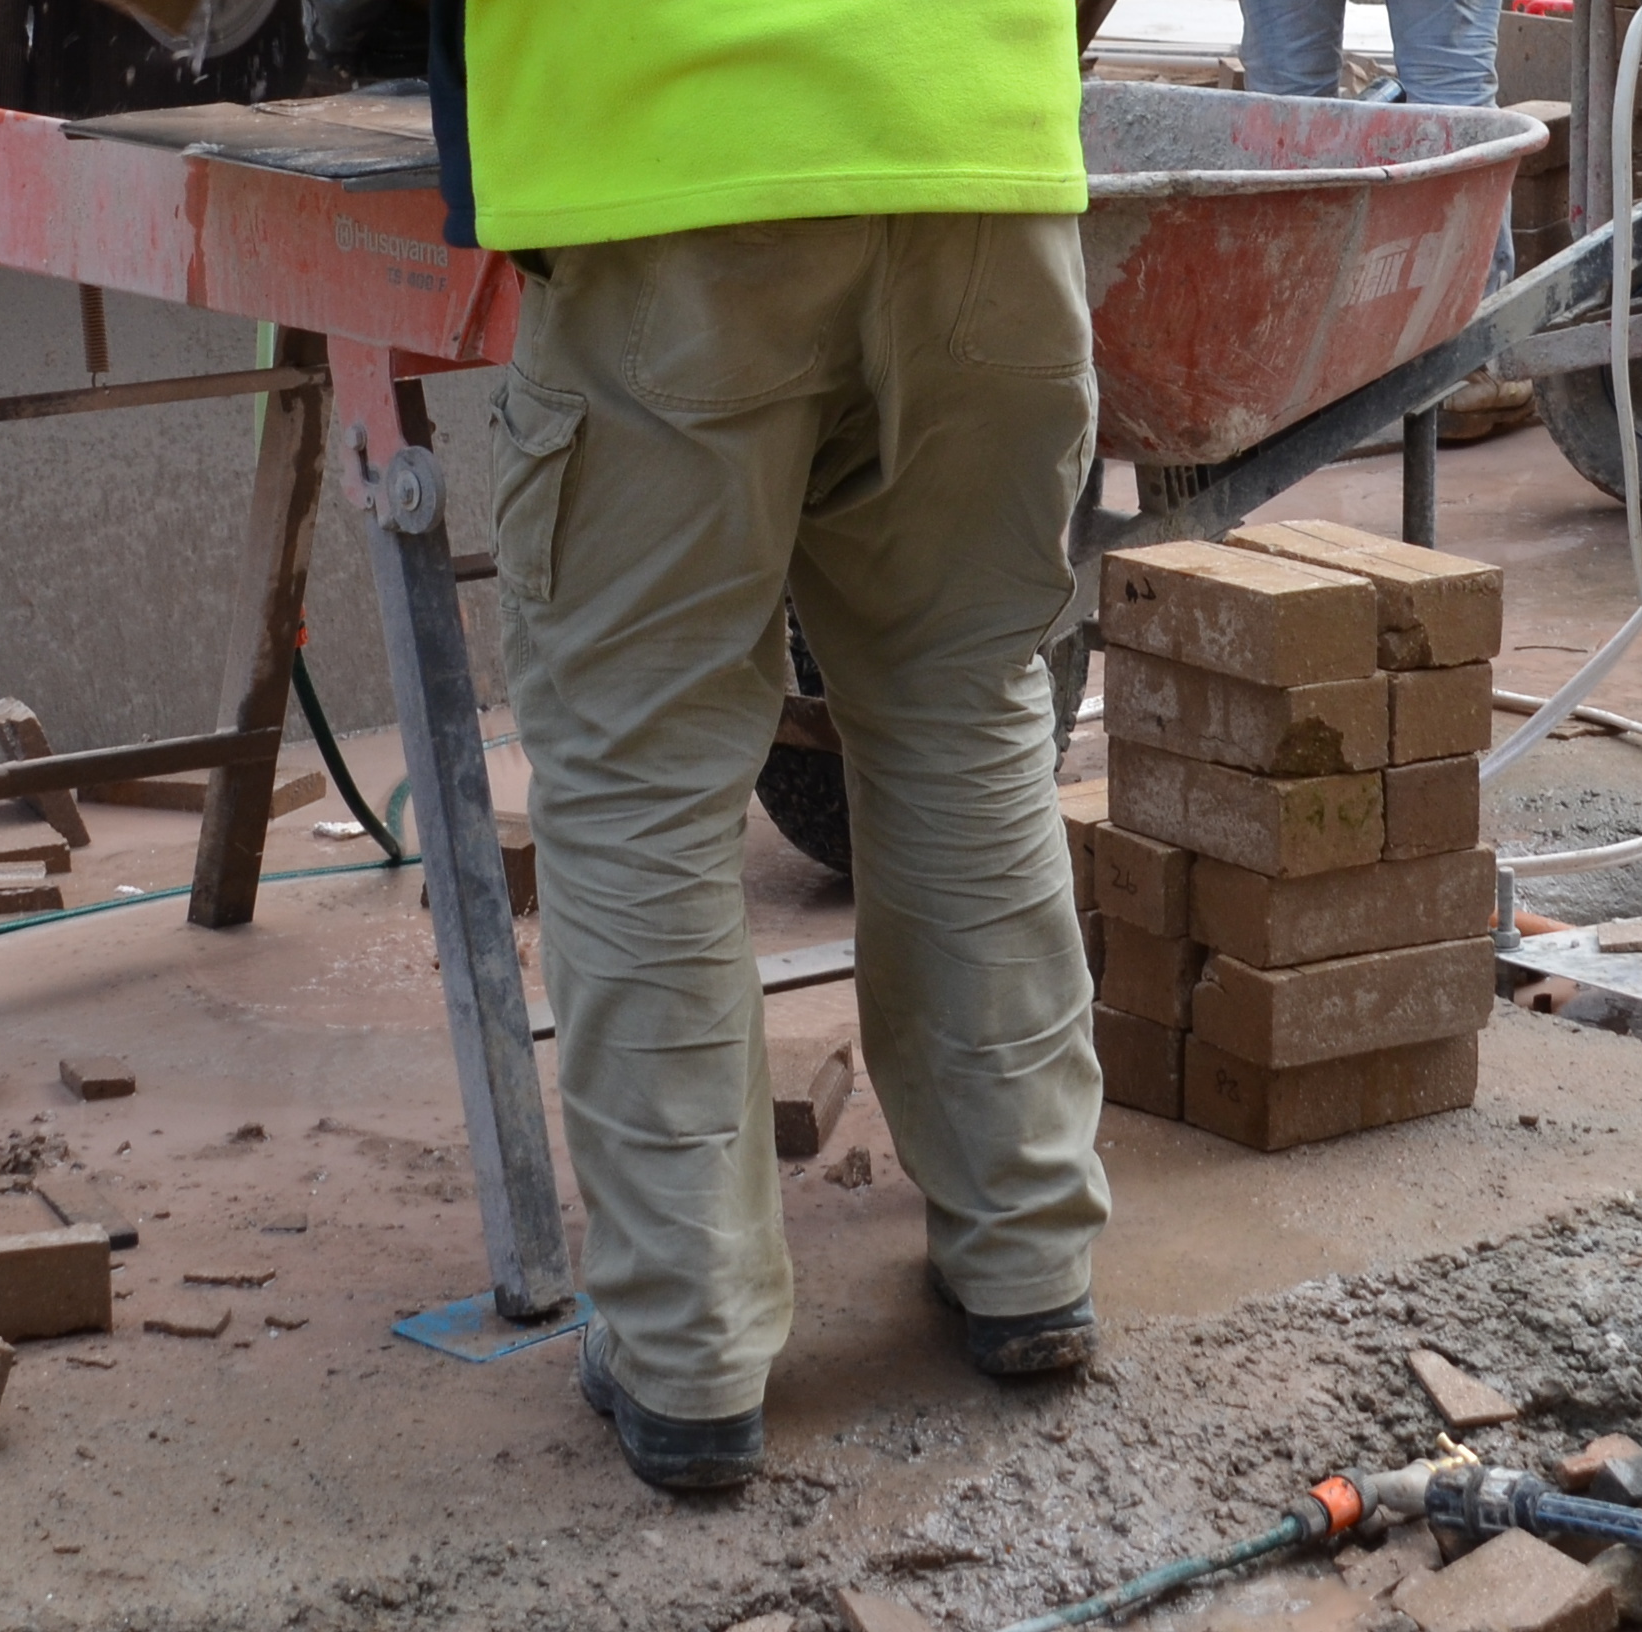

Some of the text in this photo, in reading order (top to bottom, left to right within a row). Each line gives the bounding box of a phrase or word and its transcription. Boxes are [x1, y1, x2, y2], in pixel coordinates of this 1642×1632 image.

[354, 222, 449, 268] Husqvarna
[387, 266, 402, 285] TS
[438, 276, 447, 291] F
